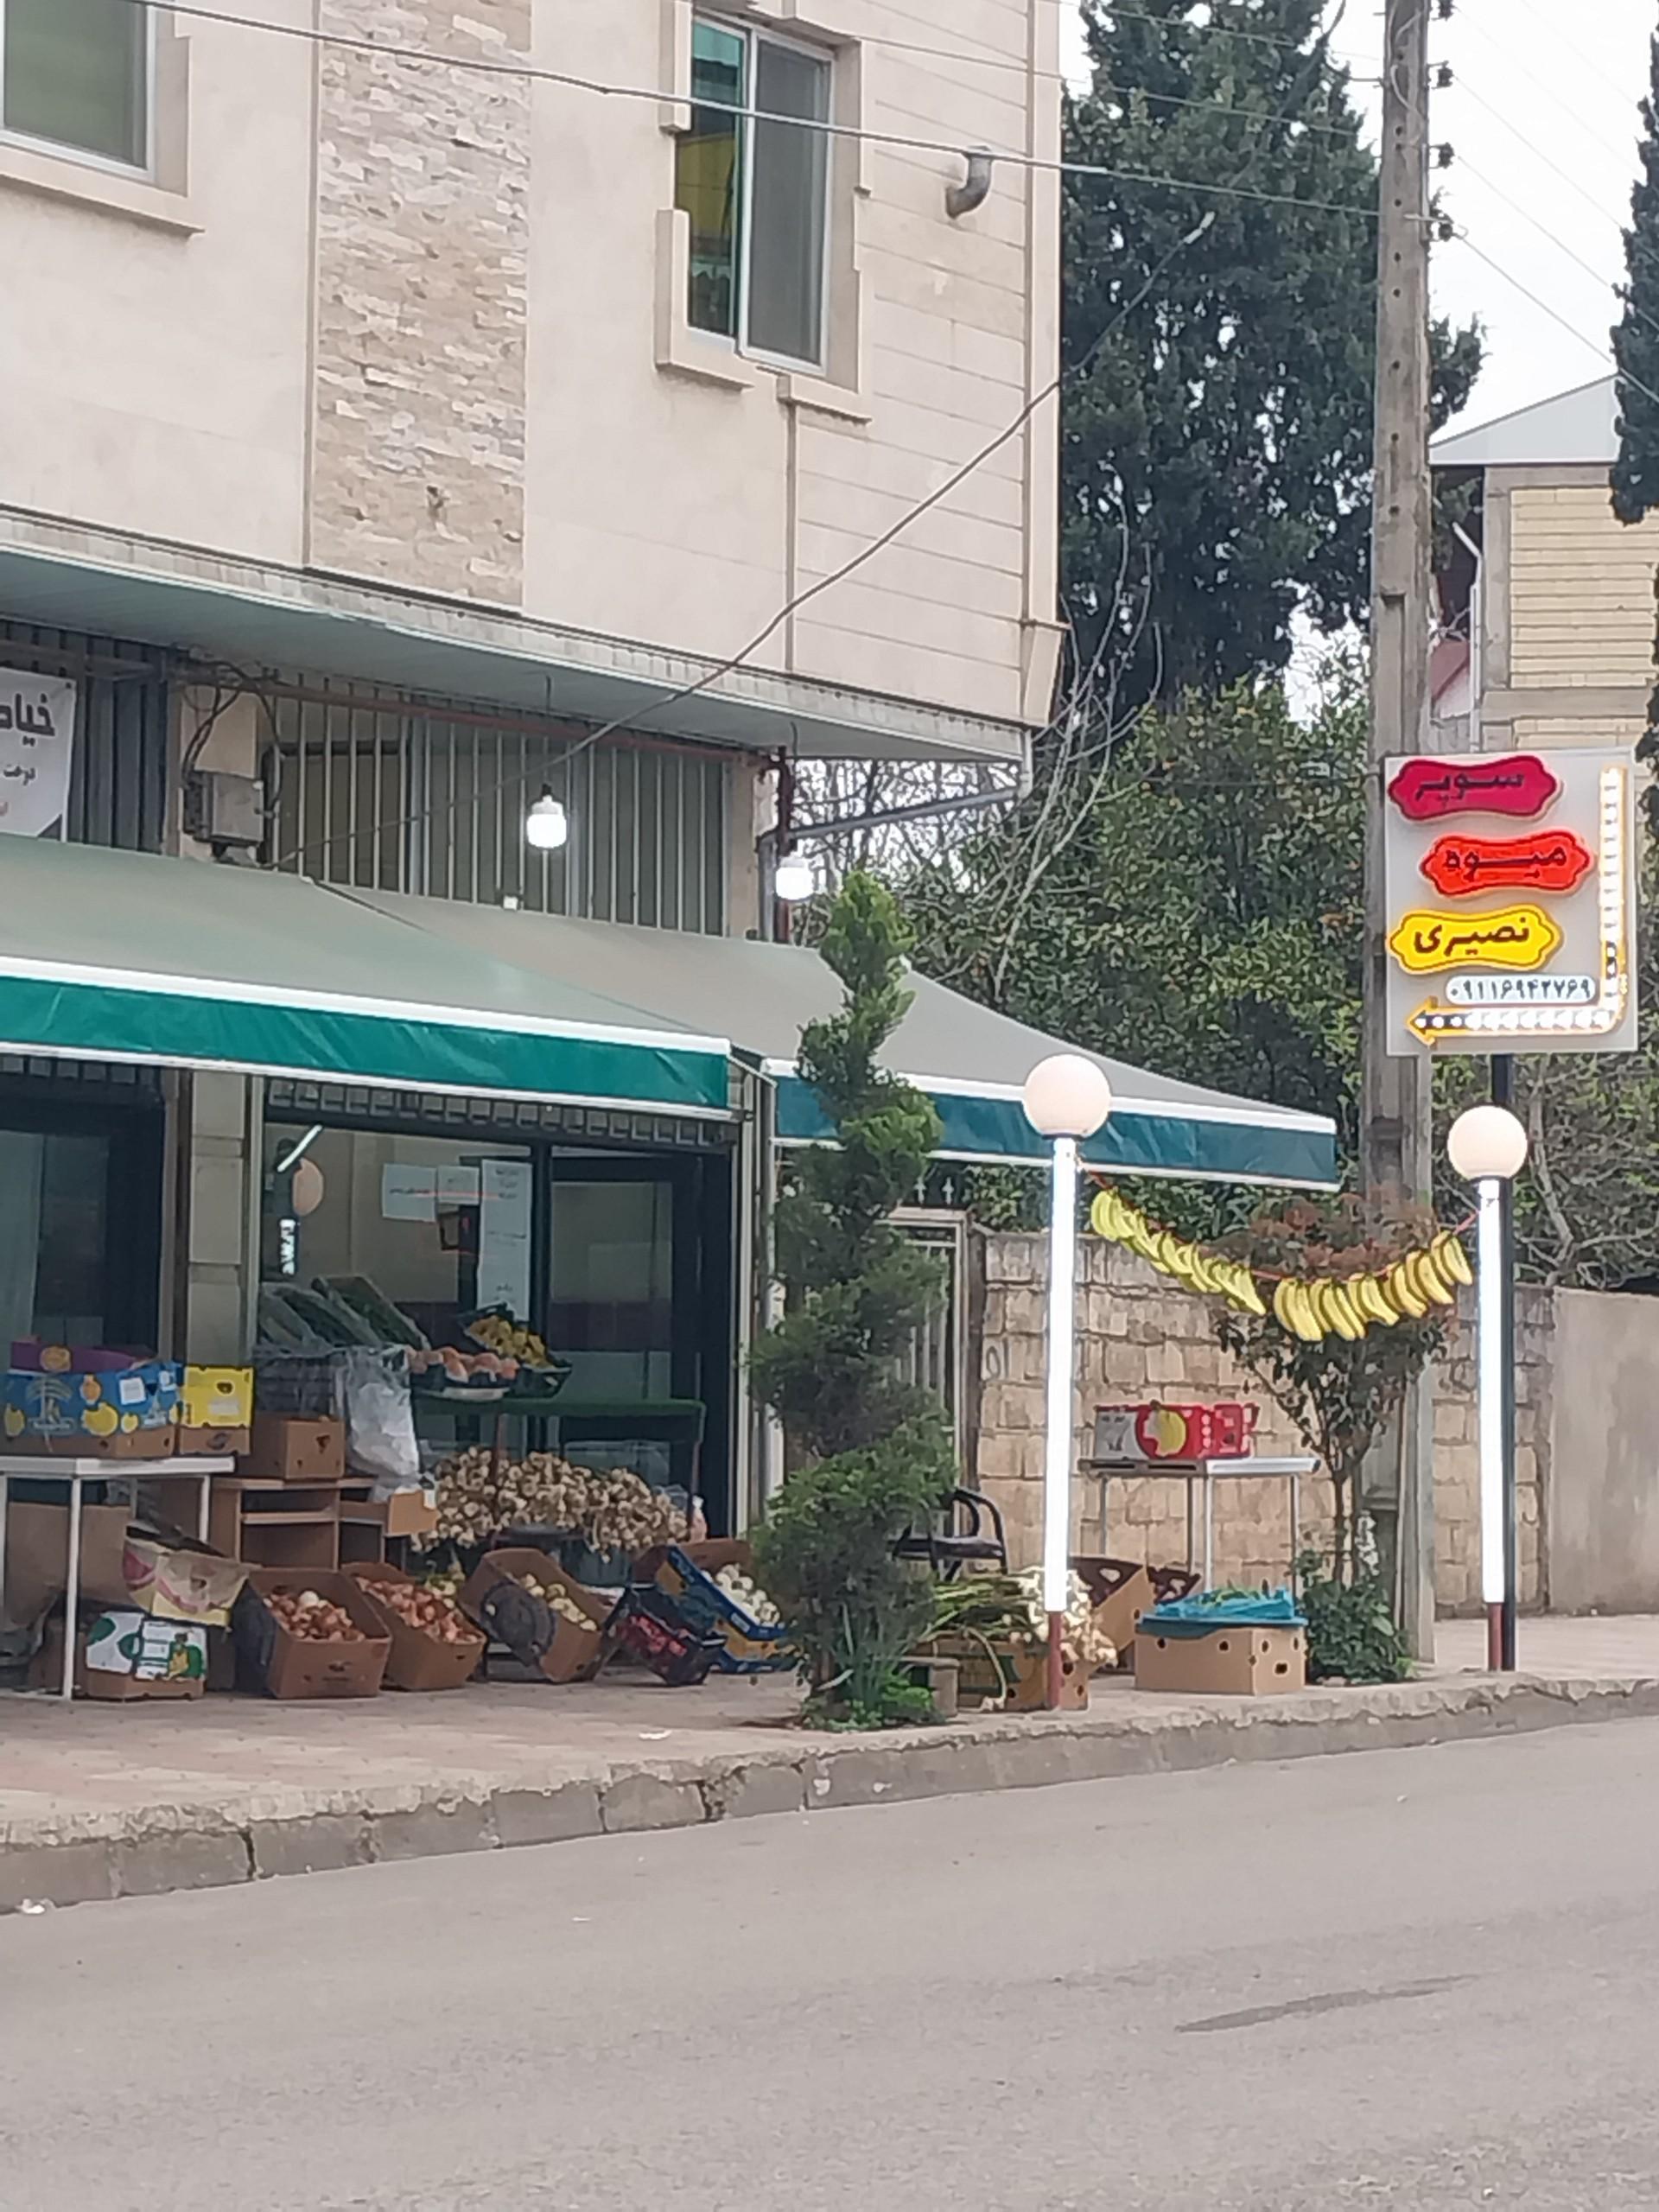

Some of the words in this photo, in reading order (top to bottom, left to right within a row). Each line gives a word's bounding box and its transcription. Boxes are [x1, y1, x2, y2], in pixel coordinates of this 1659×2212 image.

[1414, 773, 1526, 807] سوپر
[1445, 846, 1567, 882] میوه
[1414, 917, 1530, 957] نصیری
